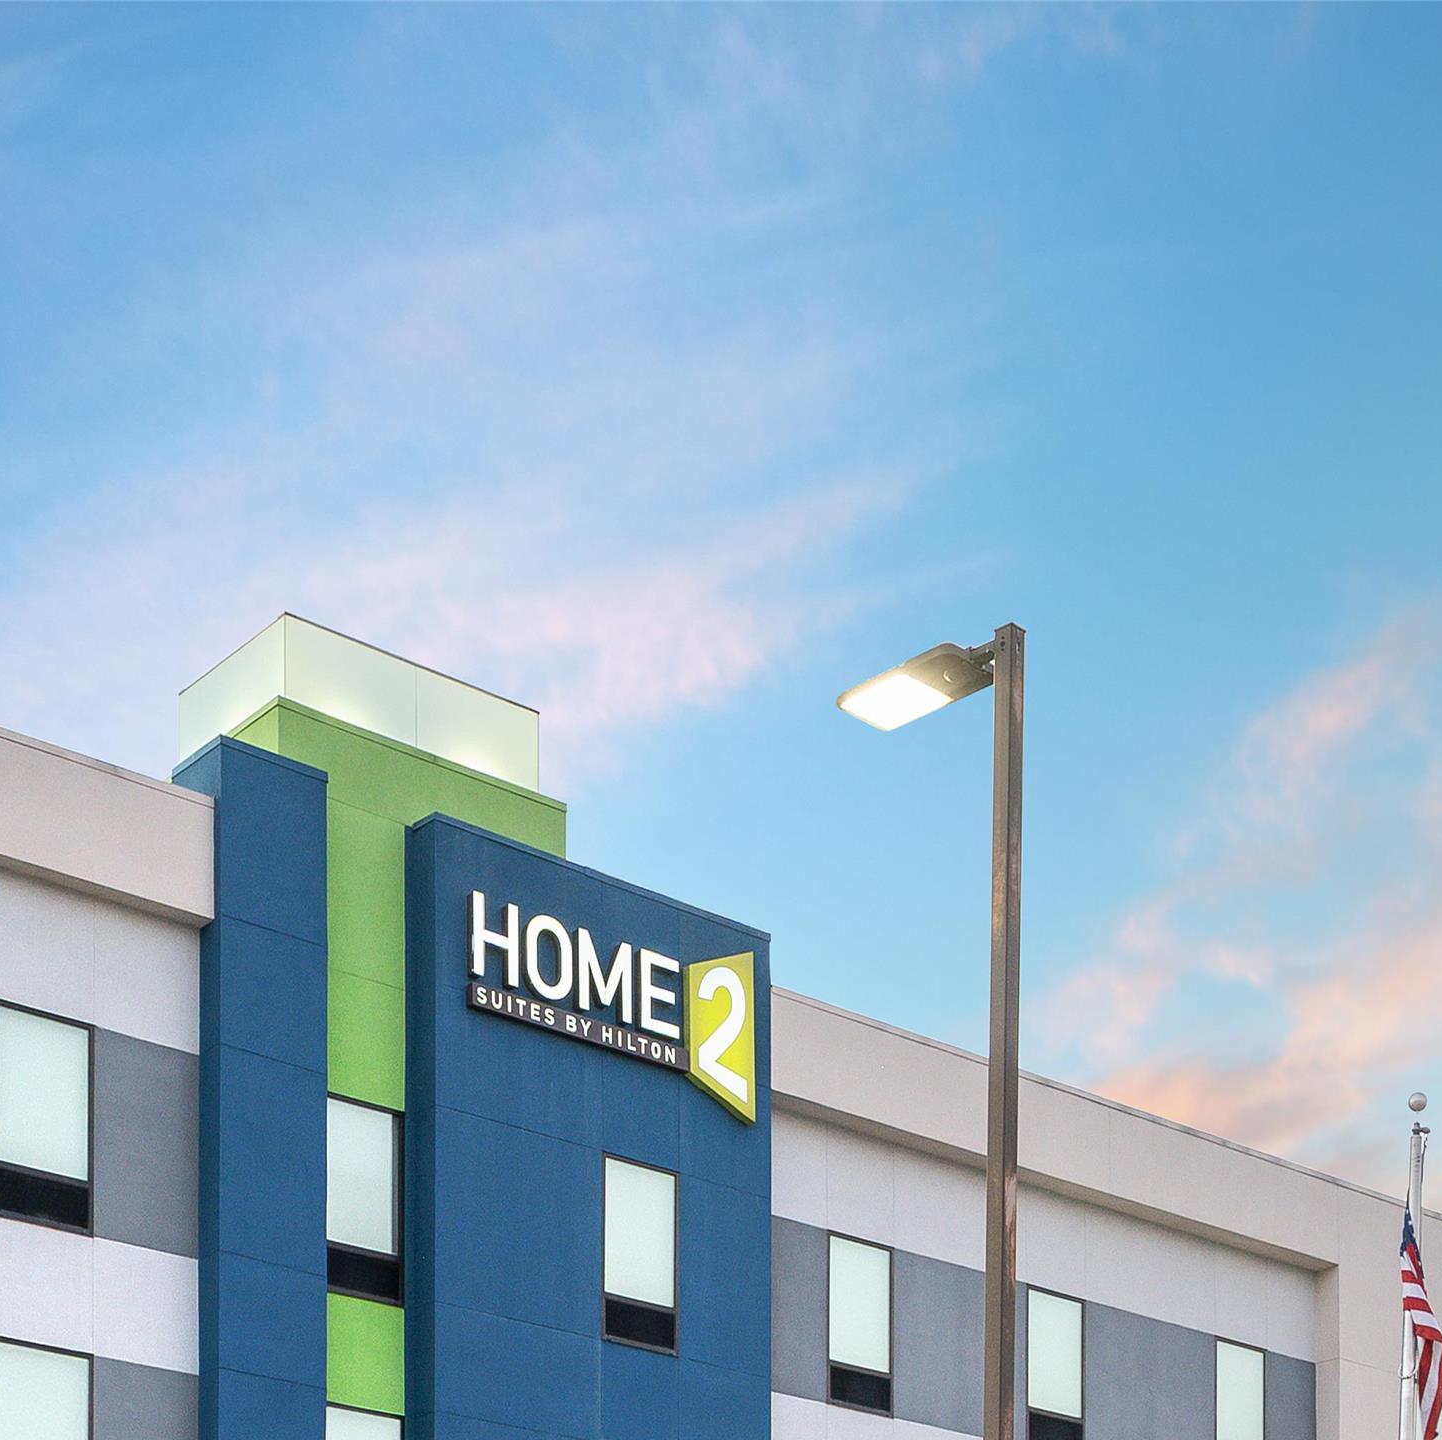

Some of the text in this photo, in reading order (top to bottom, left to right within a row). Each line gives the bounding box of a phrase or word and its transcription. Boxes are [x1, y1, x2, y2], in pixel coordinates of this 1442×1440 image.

[470, 889, 748, 1104] HOME 2
[475, 986, 676, 1065] SUITES BY HILTON
